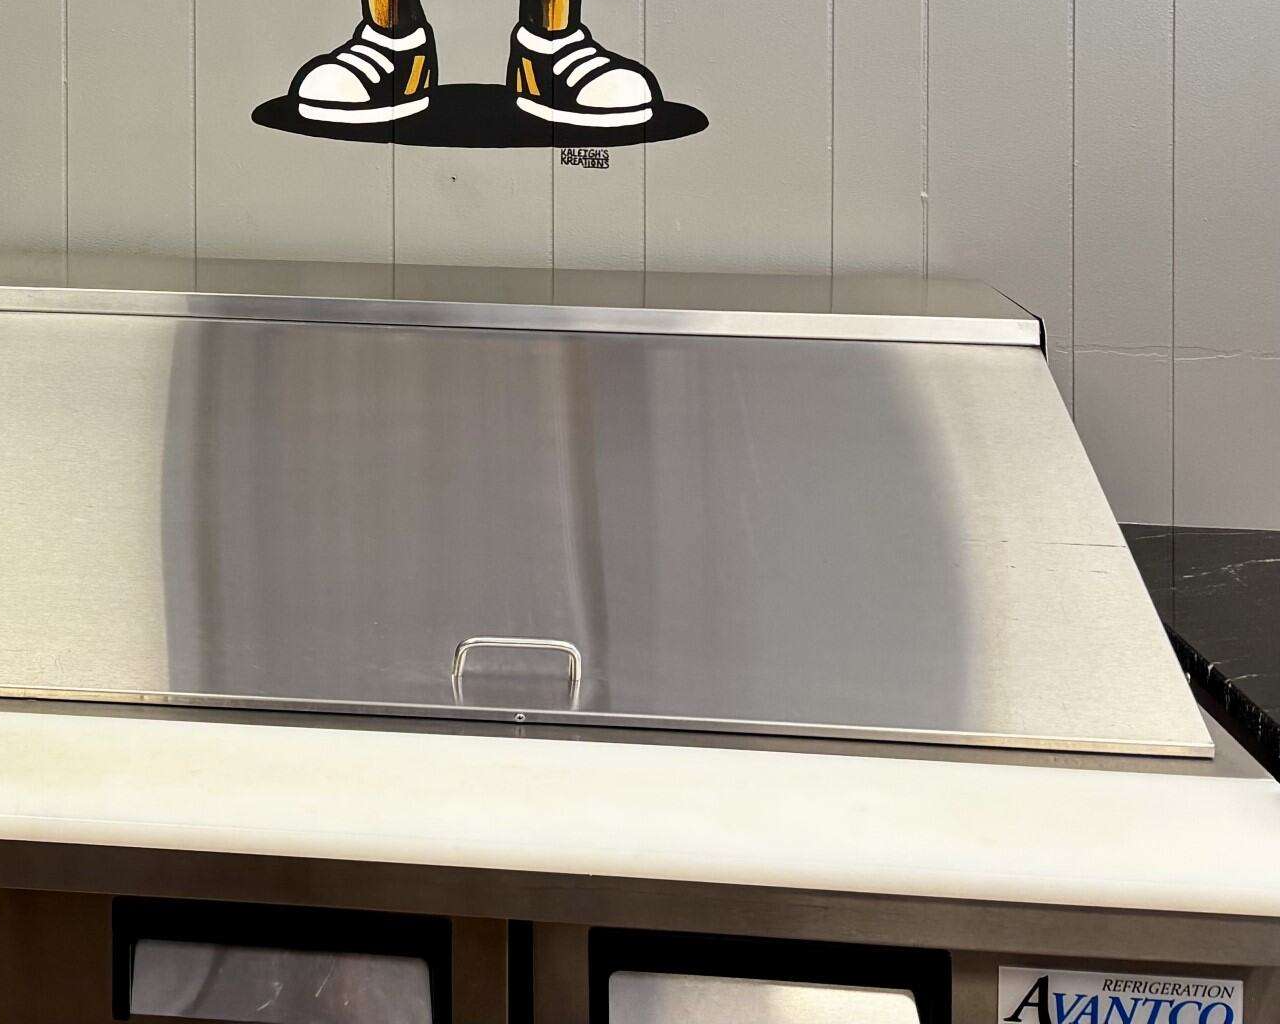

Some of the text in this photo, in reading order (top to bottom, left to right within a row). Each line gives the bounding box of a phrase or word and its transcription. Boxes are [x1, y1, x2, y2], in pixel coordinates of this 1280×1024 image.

[560, 148, 609, 158] KALEIGH'S
[560, 156, 609, 168] KREATIONS
[1101, 978, 1235, 999] REFRIGERATION
[1003, 975, 1236, 1024] AVANTCO
